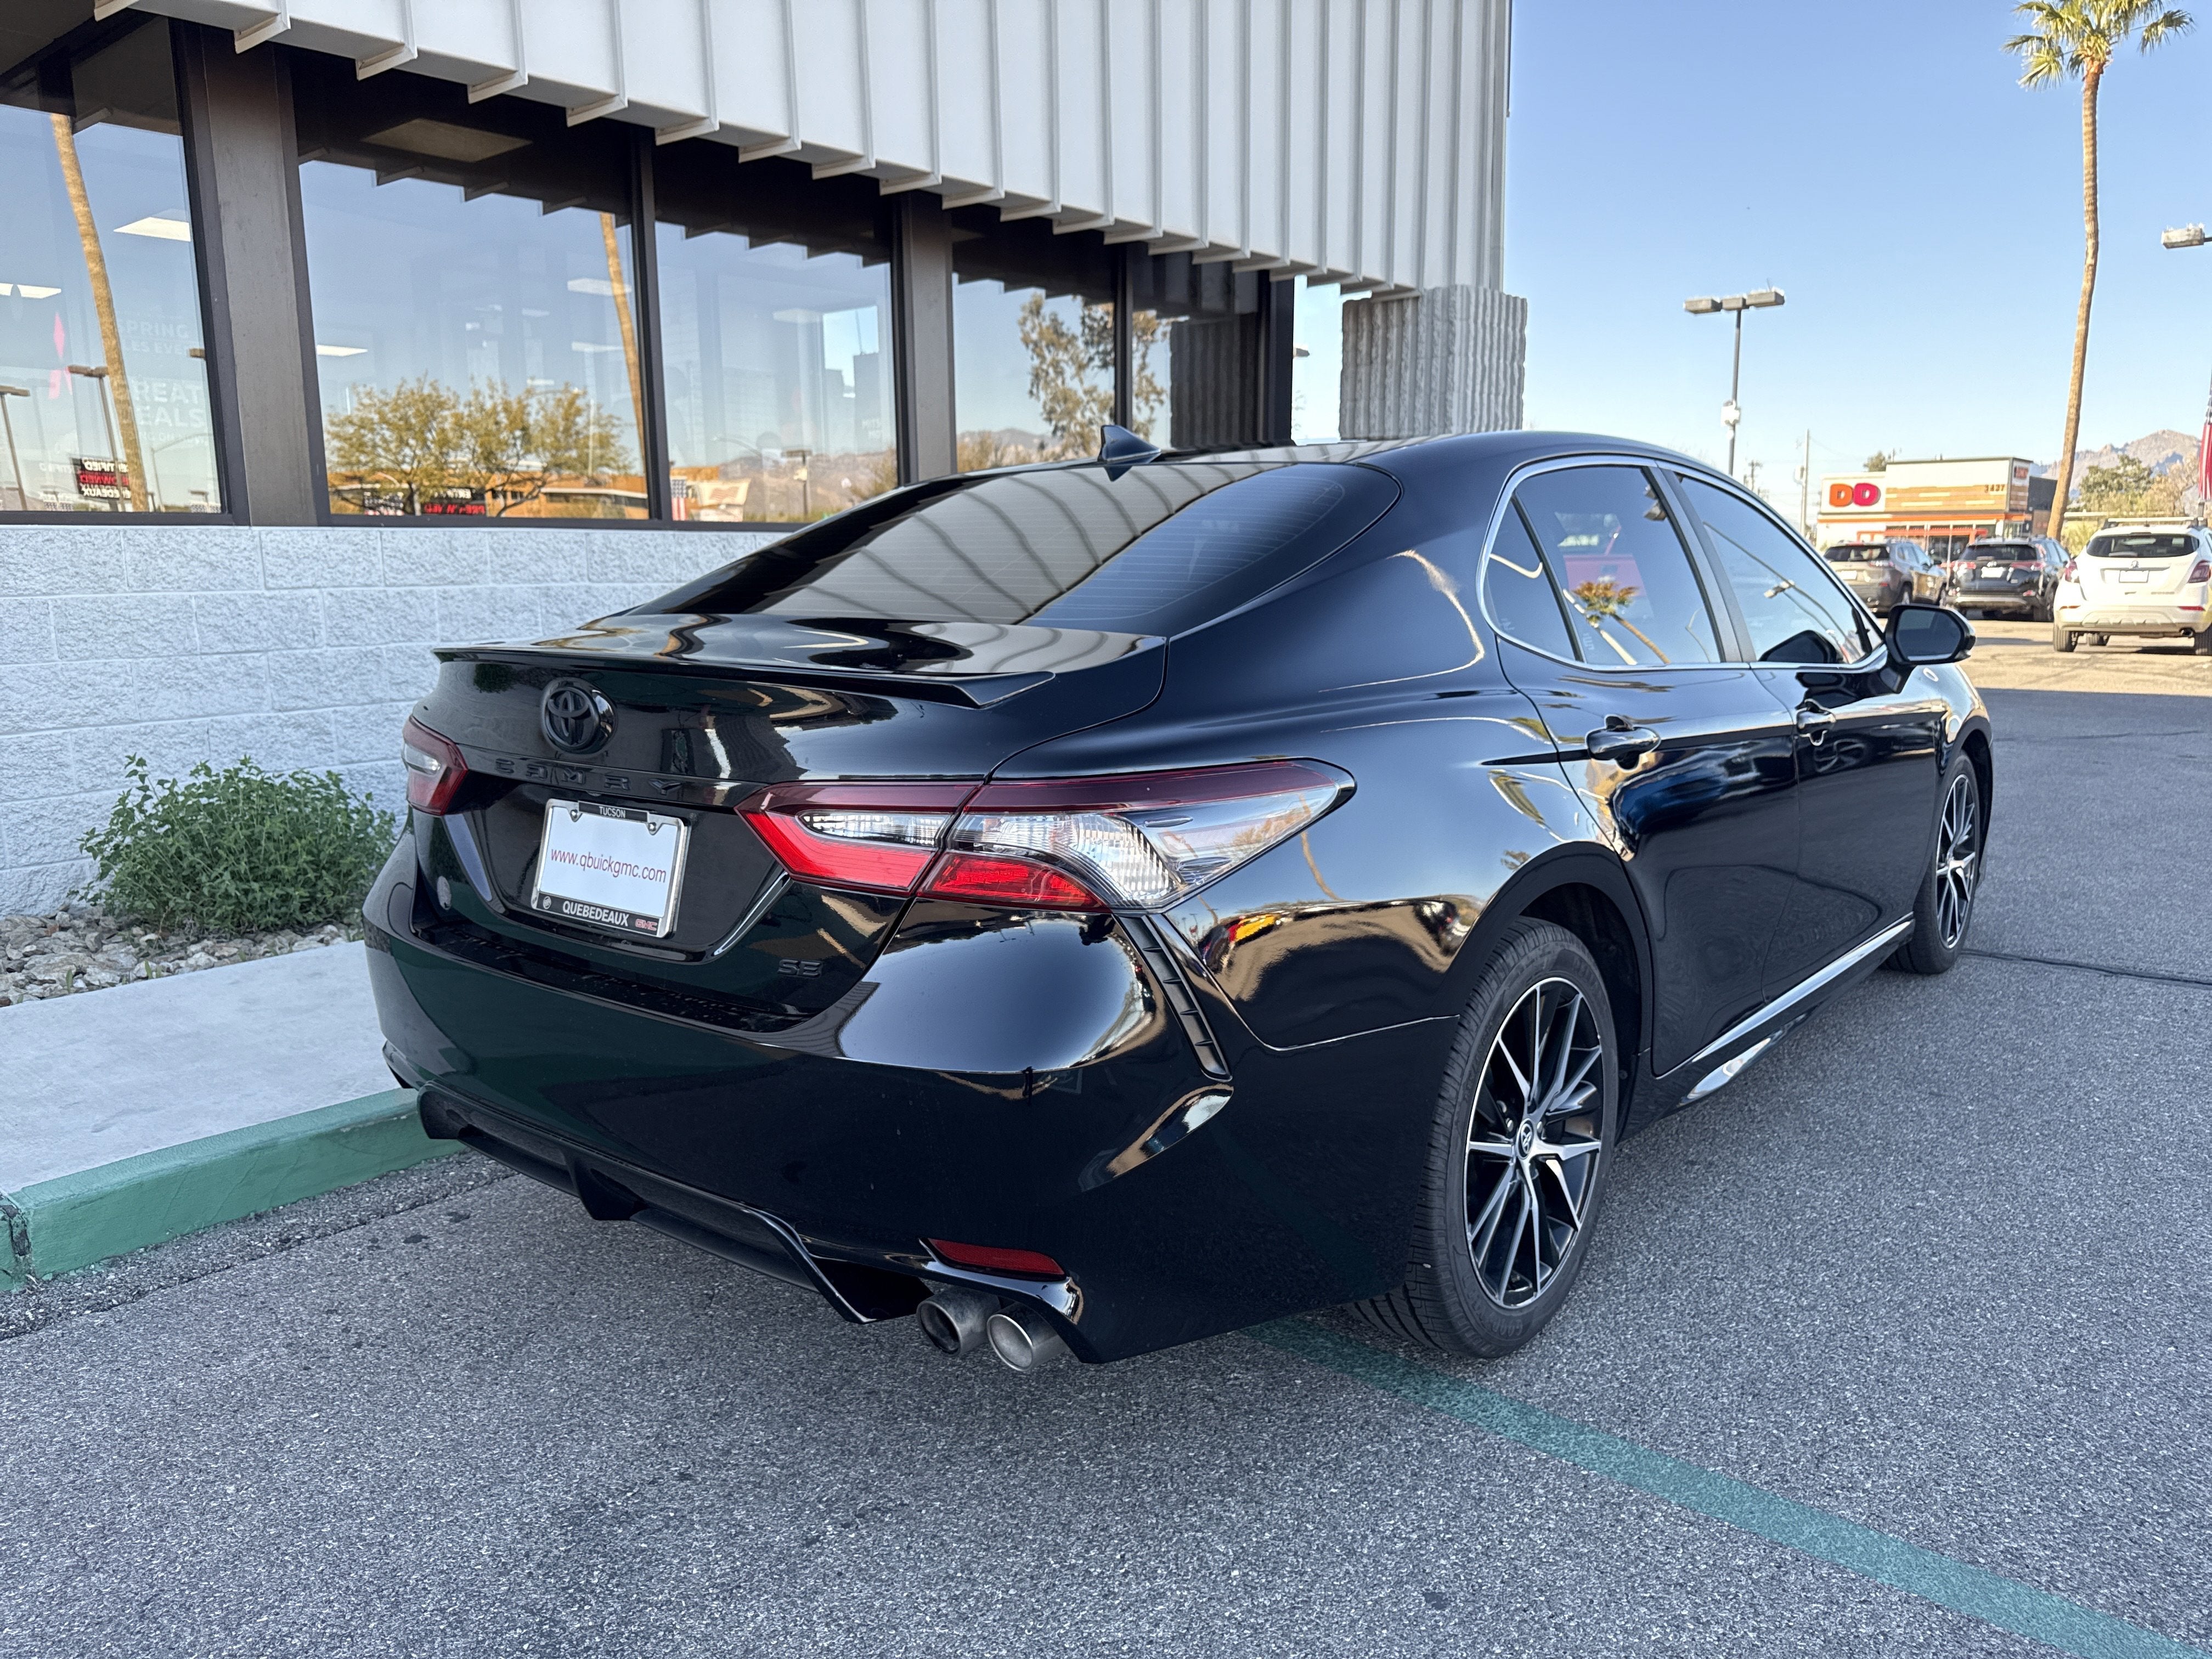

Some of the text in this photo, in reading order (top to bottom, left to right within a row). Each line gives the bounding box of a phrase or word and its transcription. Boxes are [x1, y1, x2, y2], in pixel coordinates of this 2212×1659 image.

[136, 379, 202, 404] REAT
[140, 405, 207, 428] EALS
[1829, 483, 1881, 507] DD
[495, 759, 682, 794] CAMRY
[599, 806, 626, 819] TUCSON
[550, 847, 667, 883] www.qbuickgmc.com
[562, 900, 658, 932] QUEBEDEAUX GMC
[777, 959, 822, 978] SE
